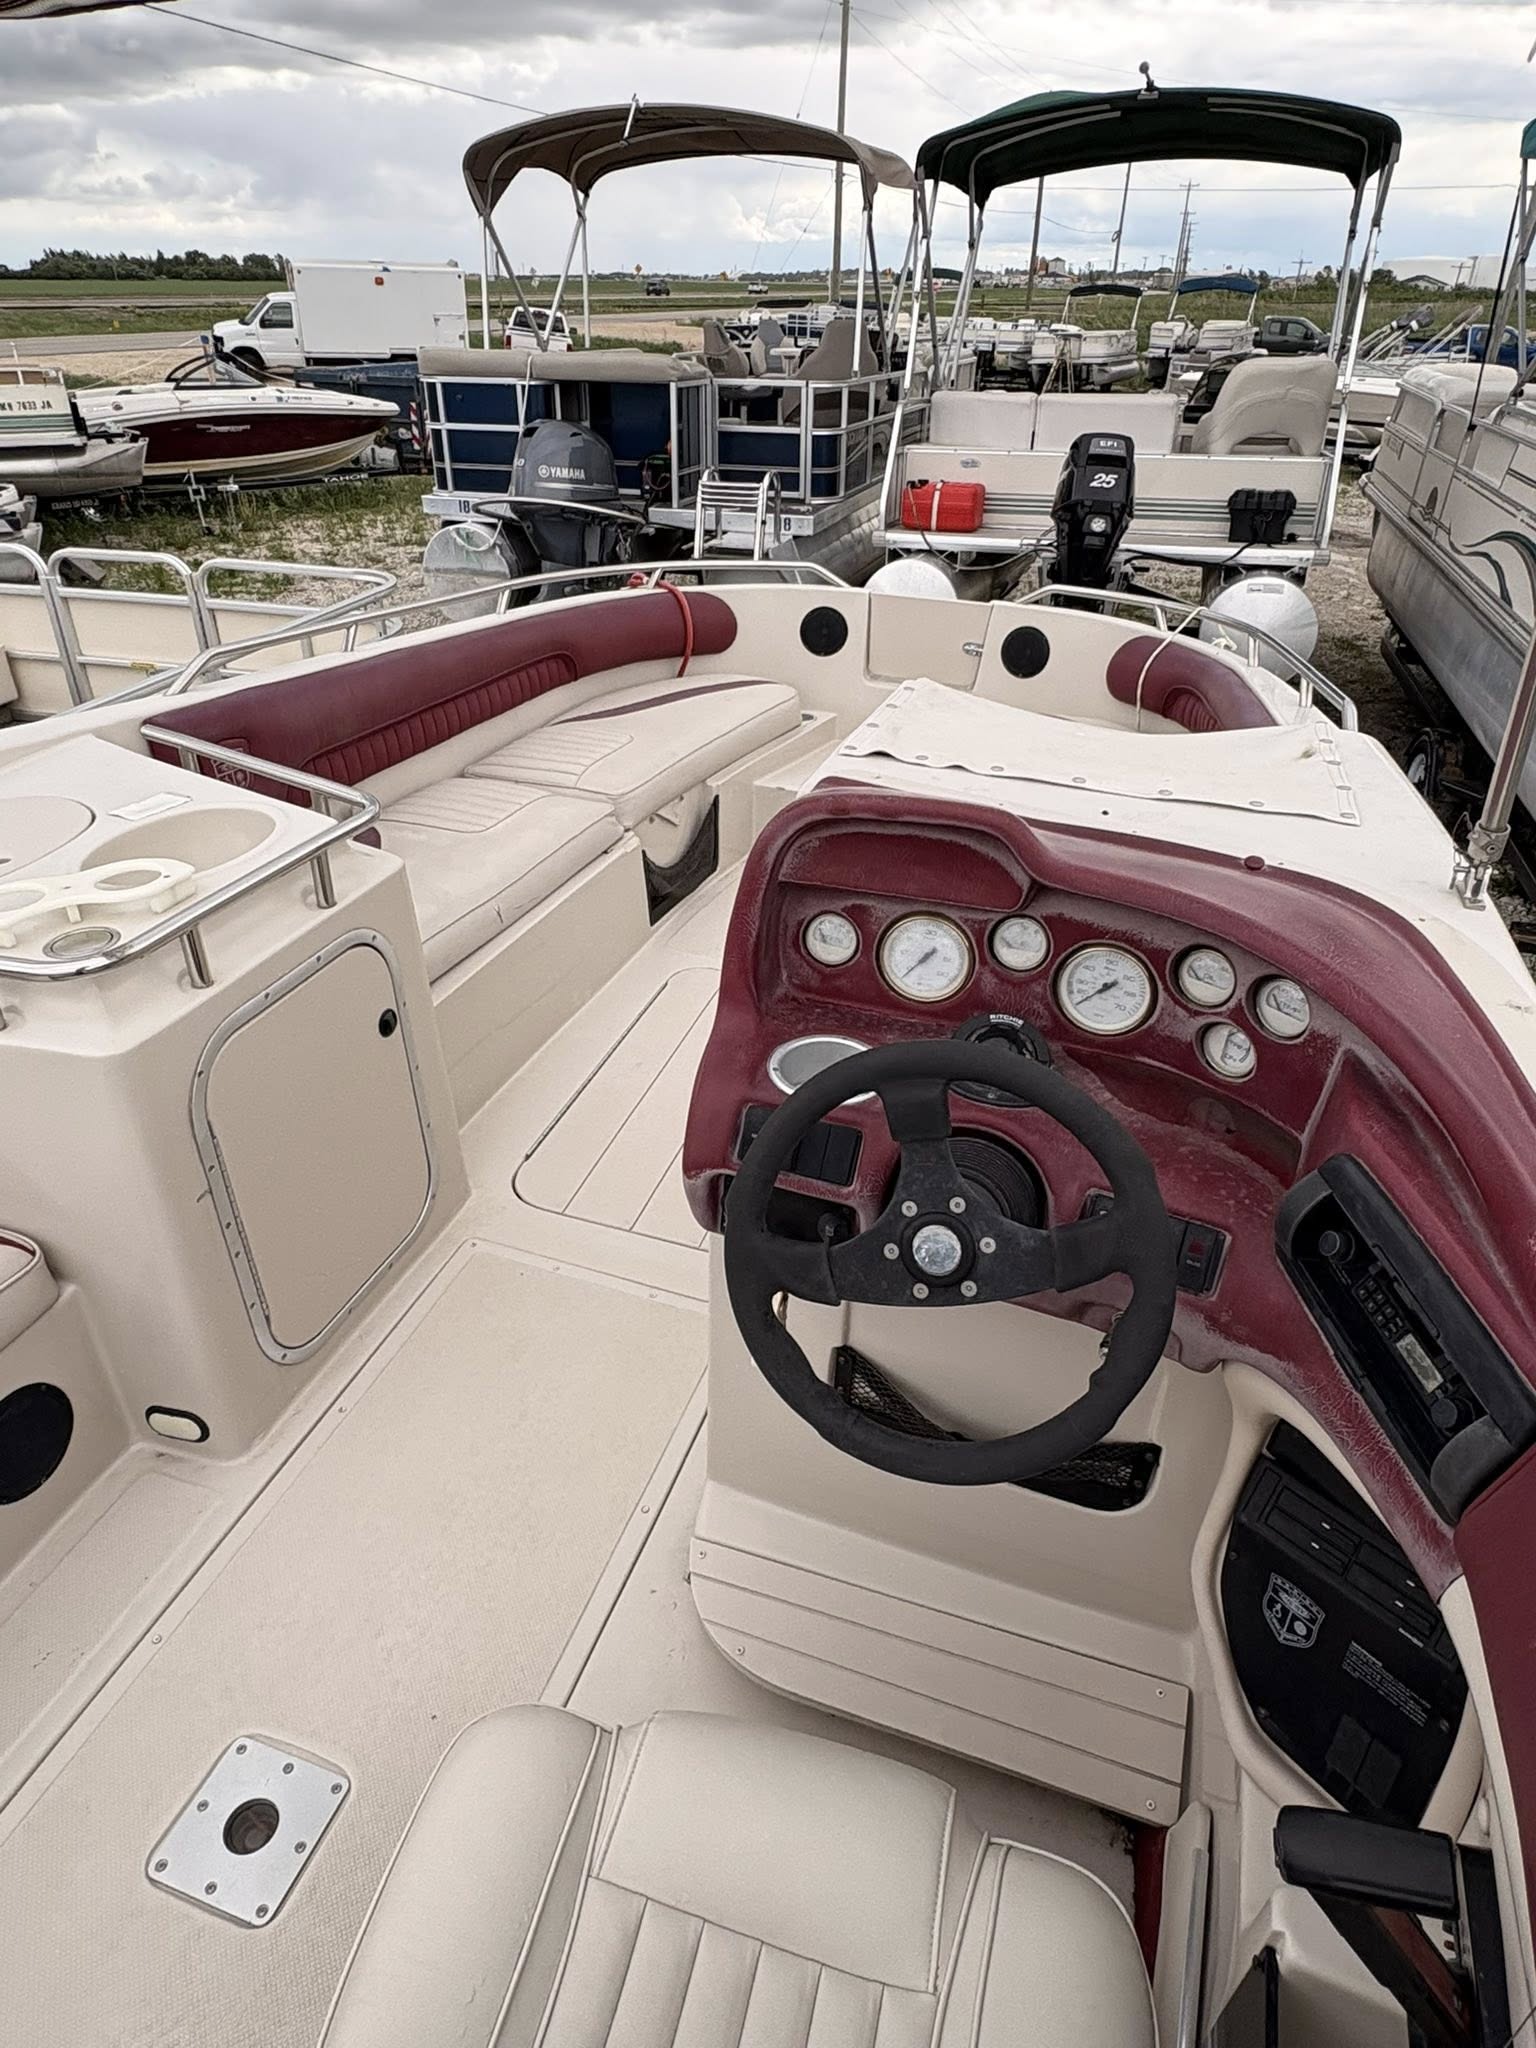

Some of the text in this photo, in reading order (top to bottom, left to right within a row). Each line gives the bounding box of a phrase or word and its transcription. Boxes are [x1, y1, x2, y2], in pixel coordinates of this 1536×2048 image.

[321, 474, 369, 483] TAHOE
[550, 466, 586, 480] YAMAHA
[1089, 473, 1118, 488] 25
[458, 500, 470, 513] 18
[990, 1013, 1025, 1025] RITCHIE
